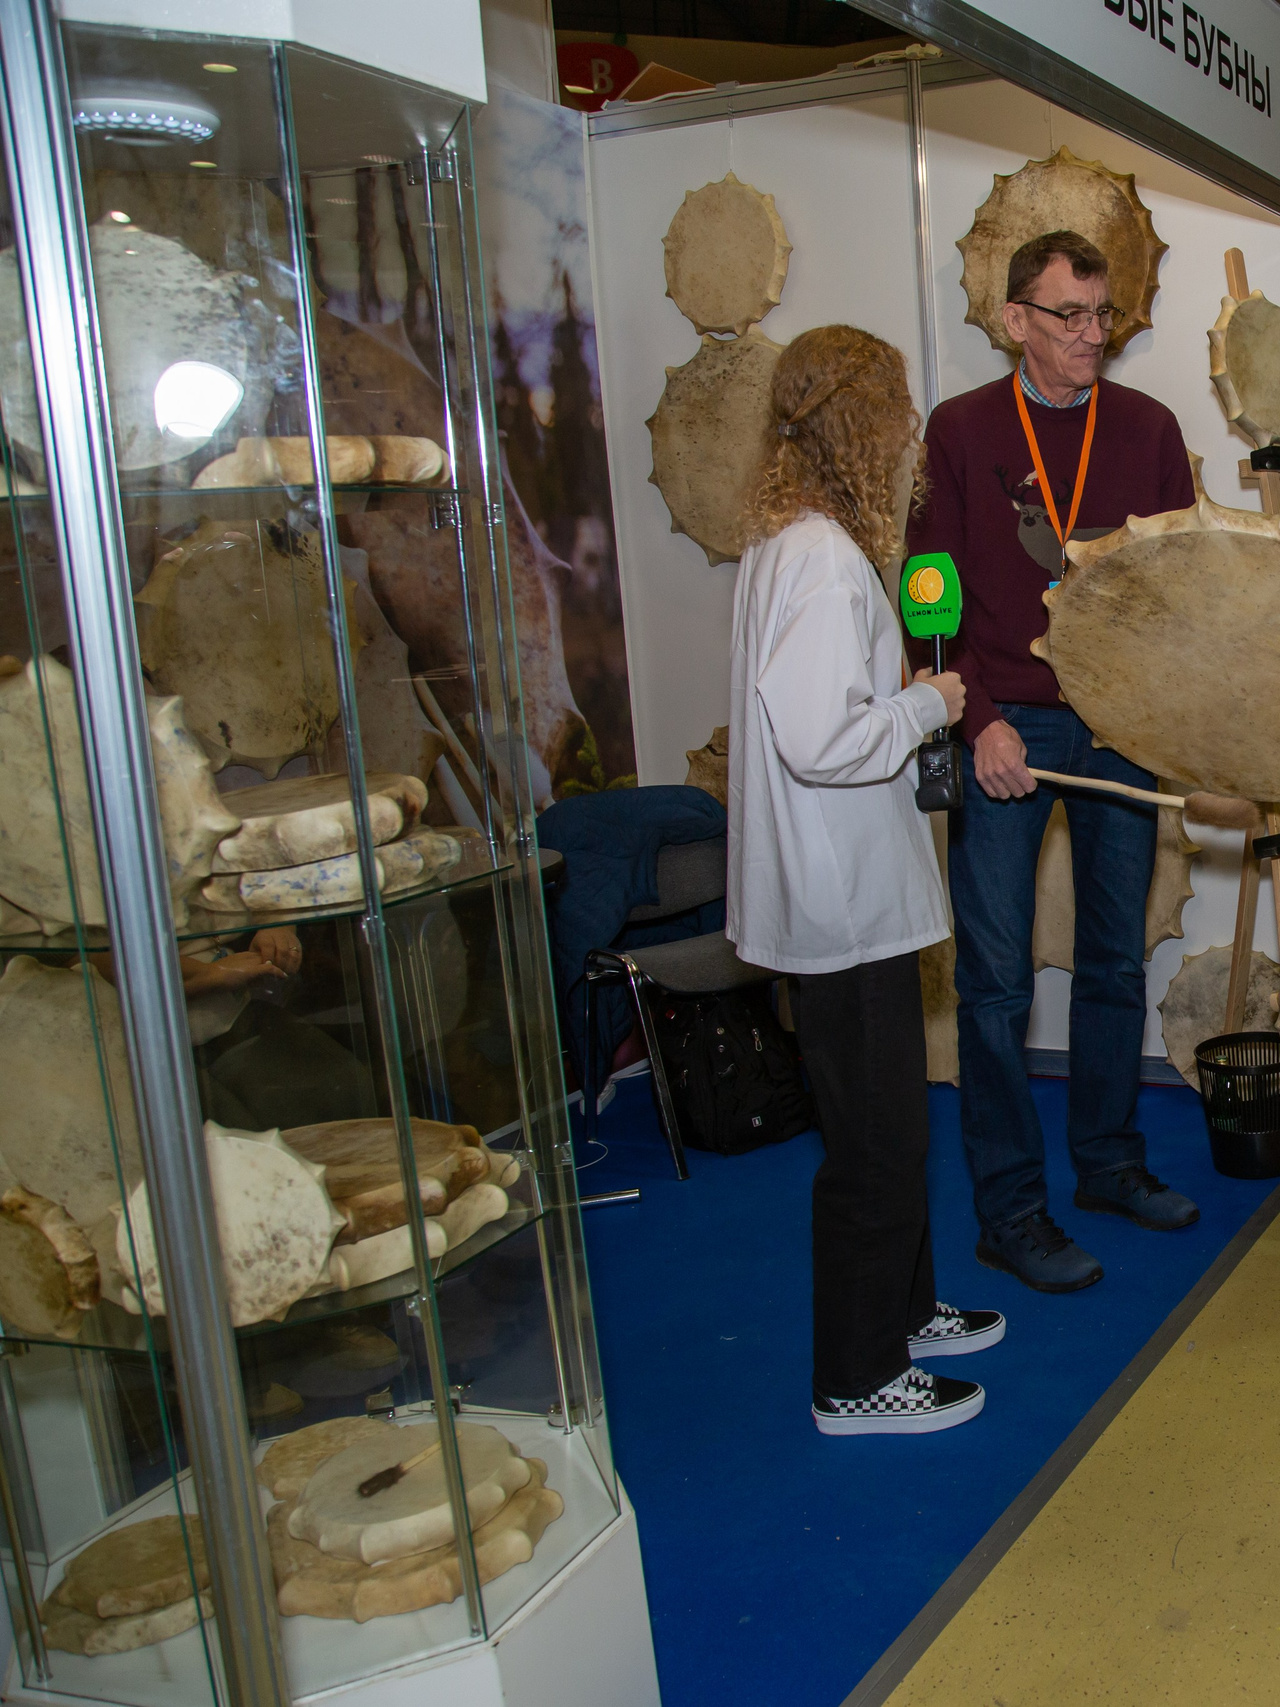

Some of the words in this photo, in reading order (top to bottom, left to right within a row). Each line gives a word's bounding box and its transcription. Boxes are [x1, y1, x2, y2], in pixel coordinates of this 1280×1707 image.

[1104, 0, 1176, 54] ЫЕ
[1182, 2, 1272, 119] БУБНЫ
[906, 609, 932, 618] LEMON
